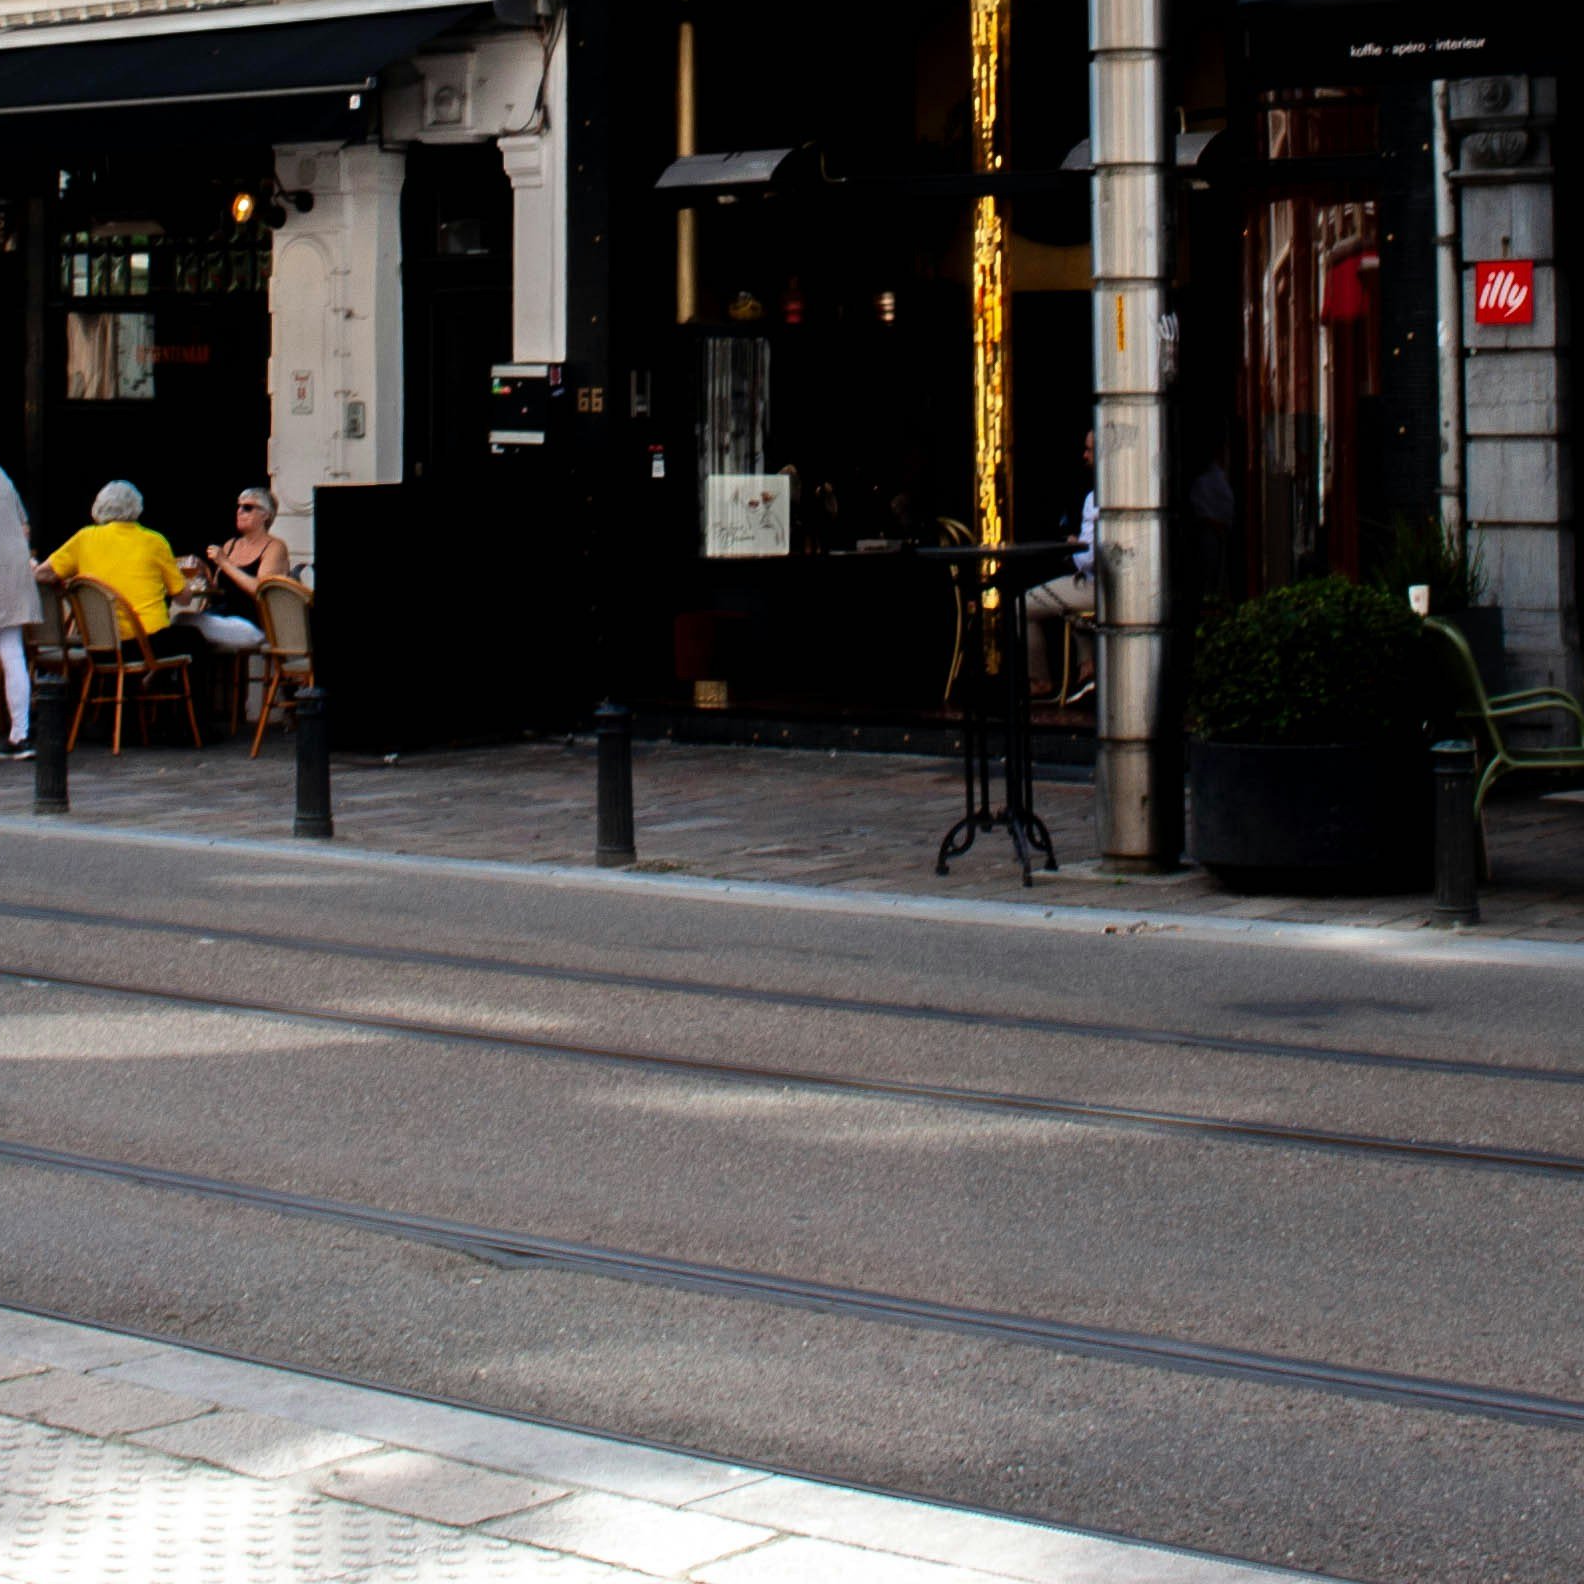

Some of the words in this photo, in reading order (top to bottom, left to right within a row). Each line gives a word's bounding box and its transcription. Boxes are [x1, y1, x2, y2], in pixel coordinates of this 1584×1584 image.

[1350, 41, 1383, 58] koffie
[1392, 37, 1426, 57] apéro
[1435, 37, 1486, 54] interieur
[1479, 269, 1528, 318] illy
[577, 387, 604, 413] 66
